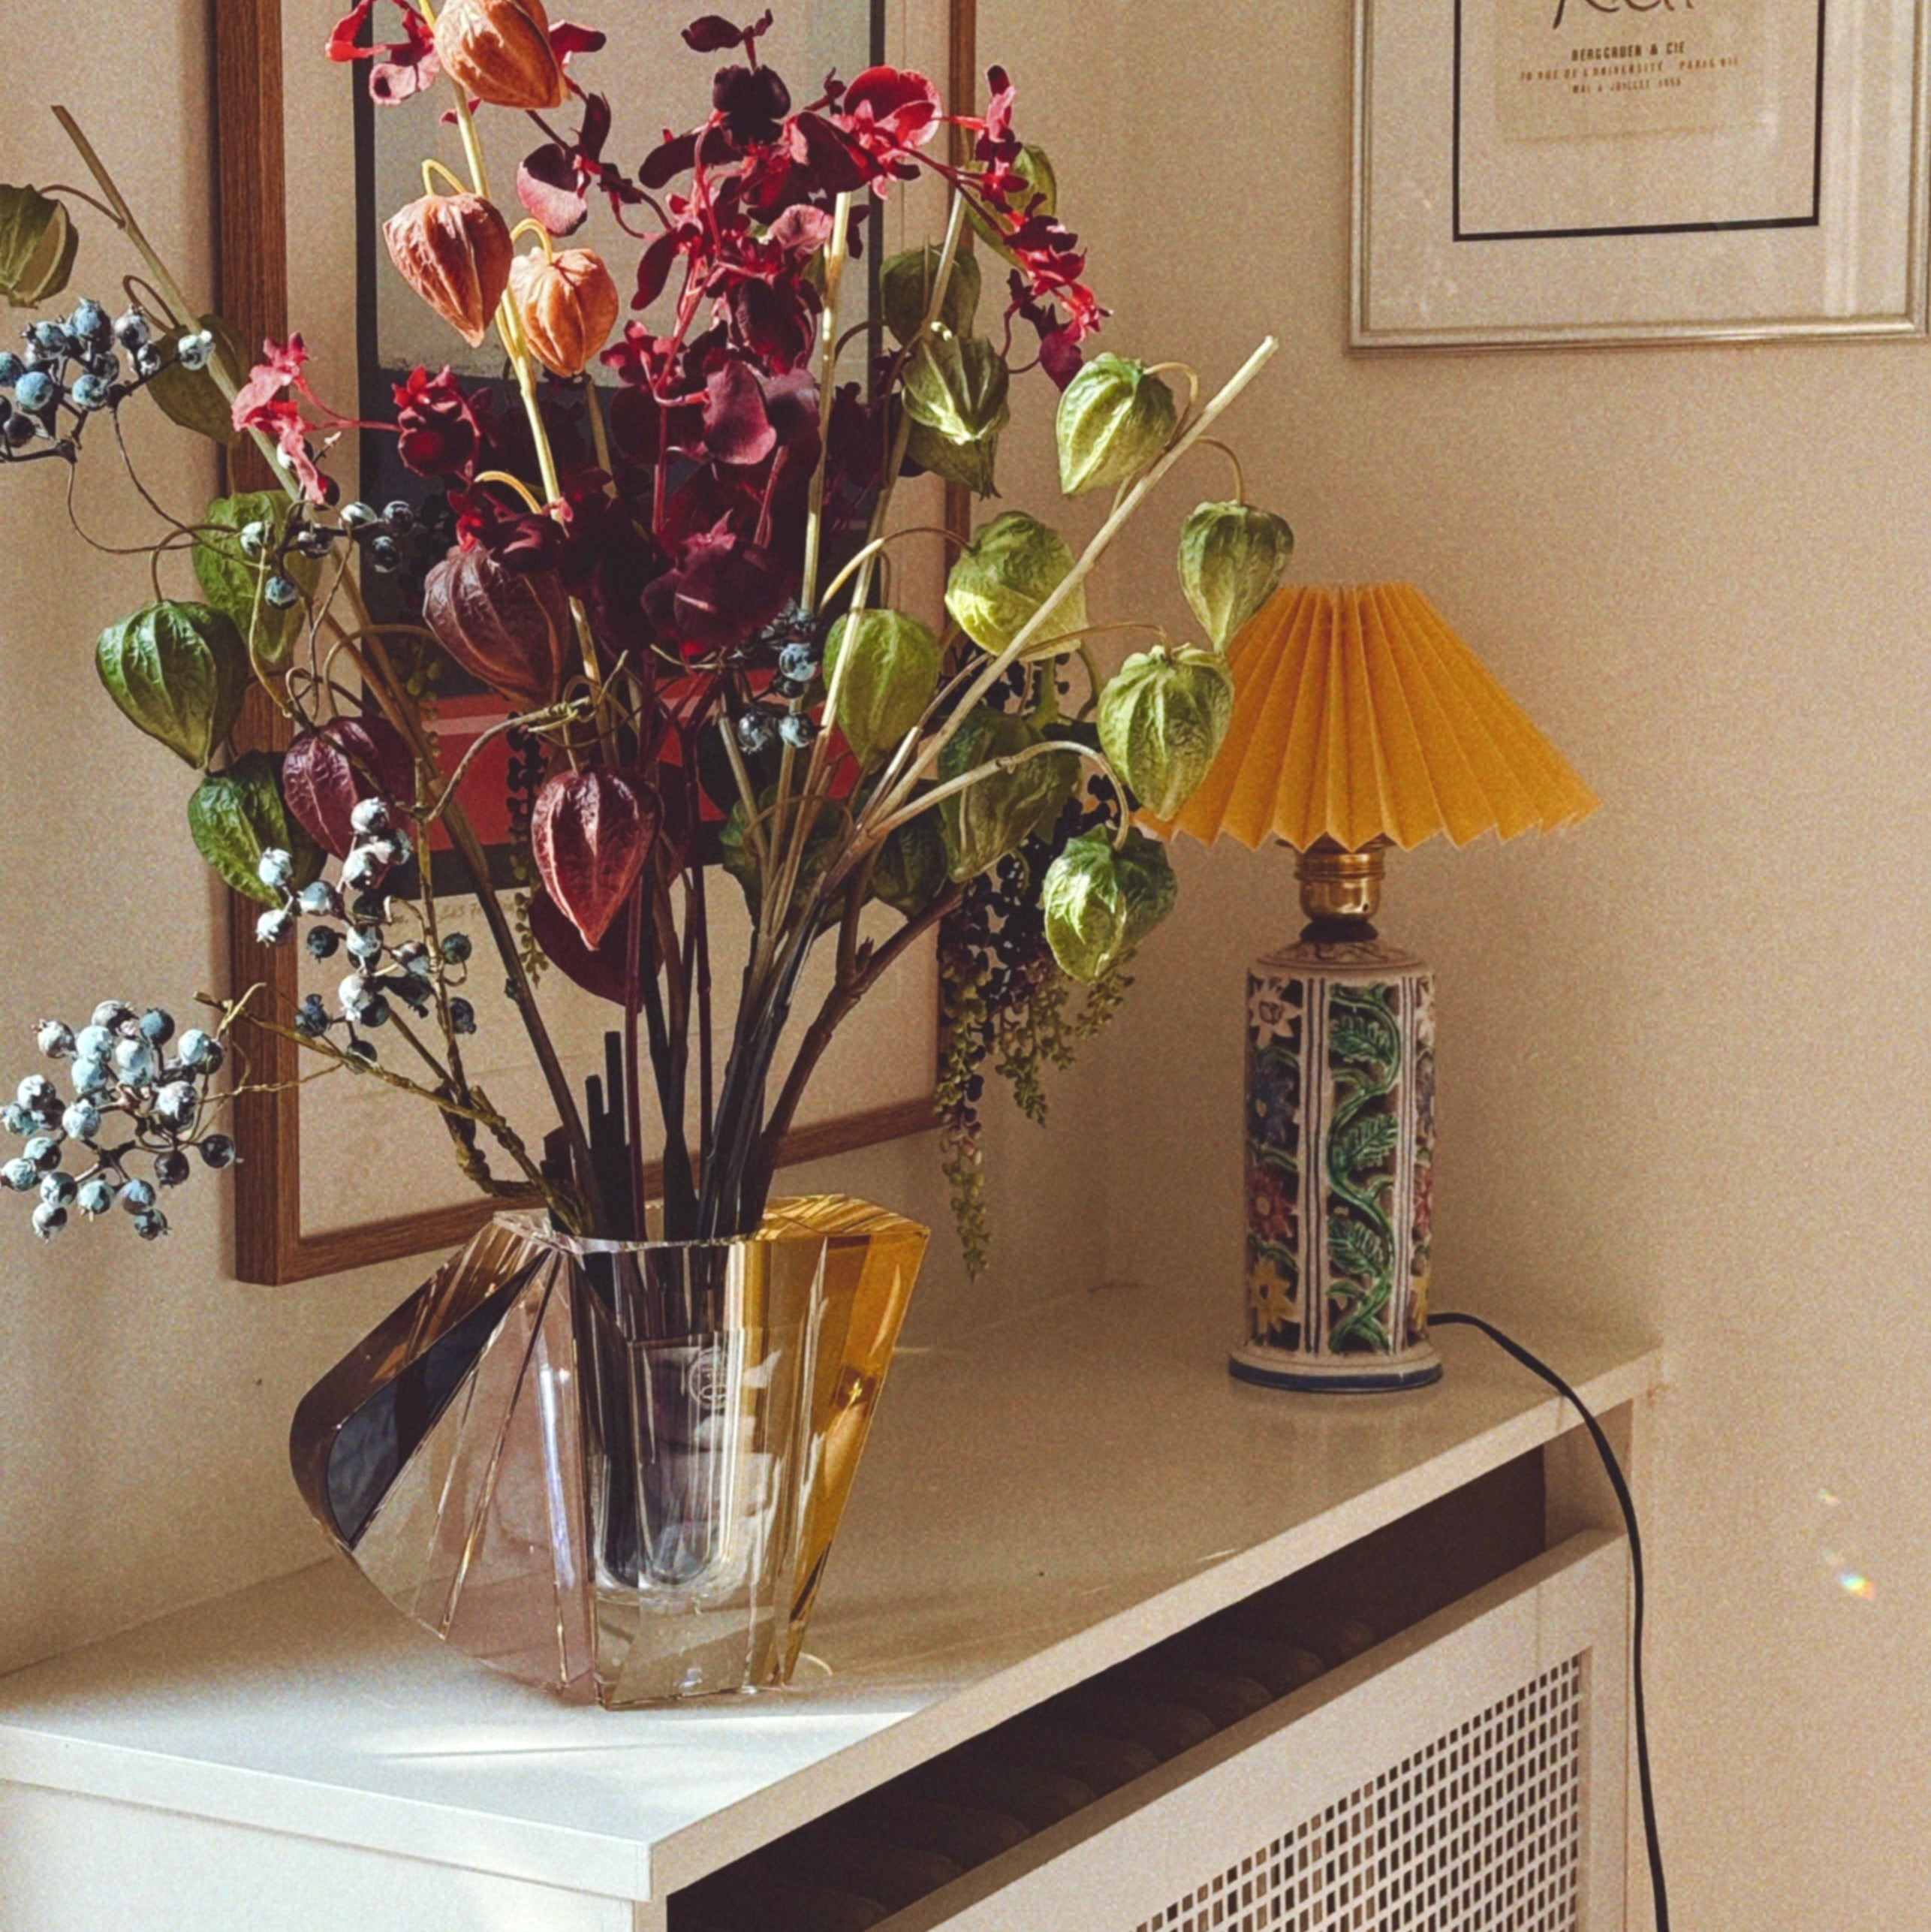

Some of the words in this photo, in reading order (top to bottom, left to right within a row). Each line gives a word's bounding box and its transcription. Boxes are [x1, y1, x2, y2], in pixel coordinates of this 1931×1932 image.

[1649, 43, 1658, 56] &
[1666, 41, 1685, 55] CIE
[1679, 59, 1716, 70] PARIS
